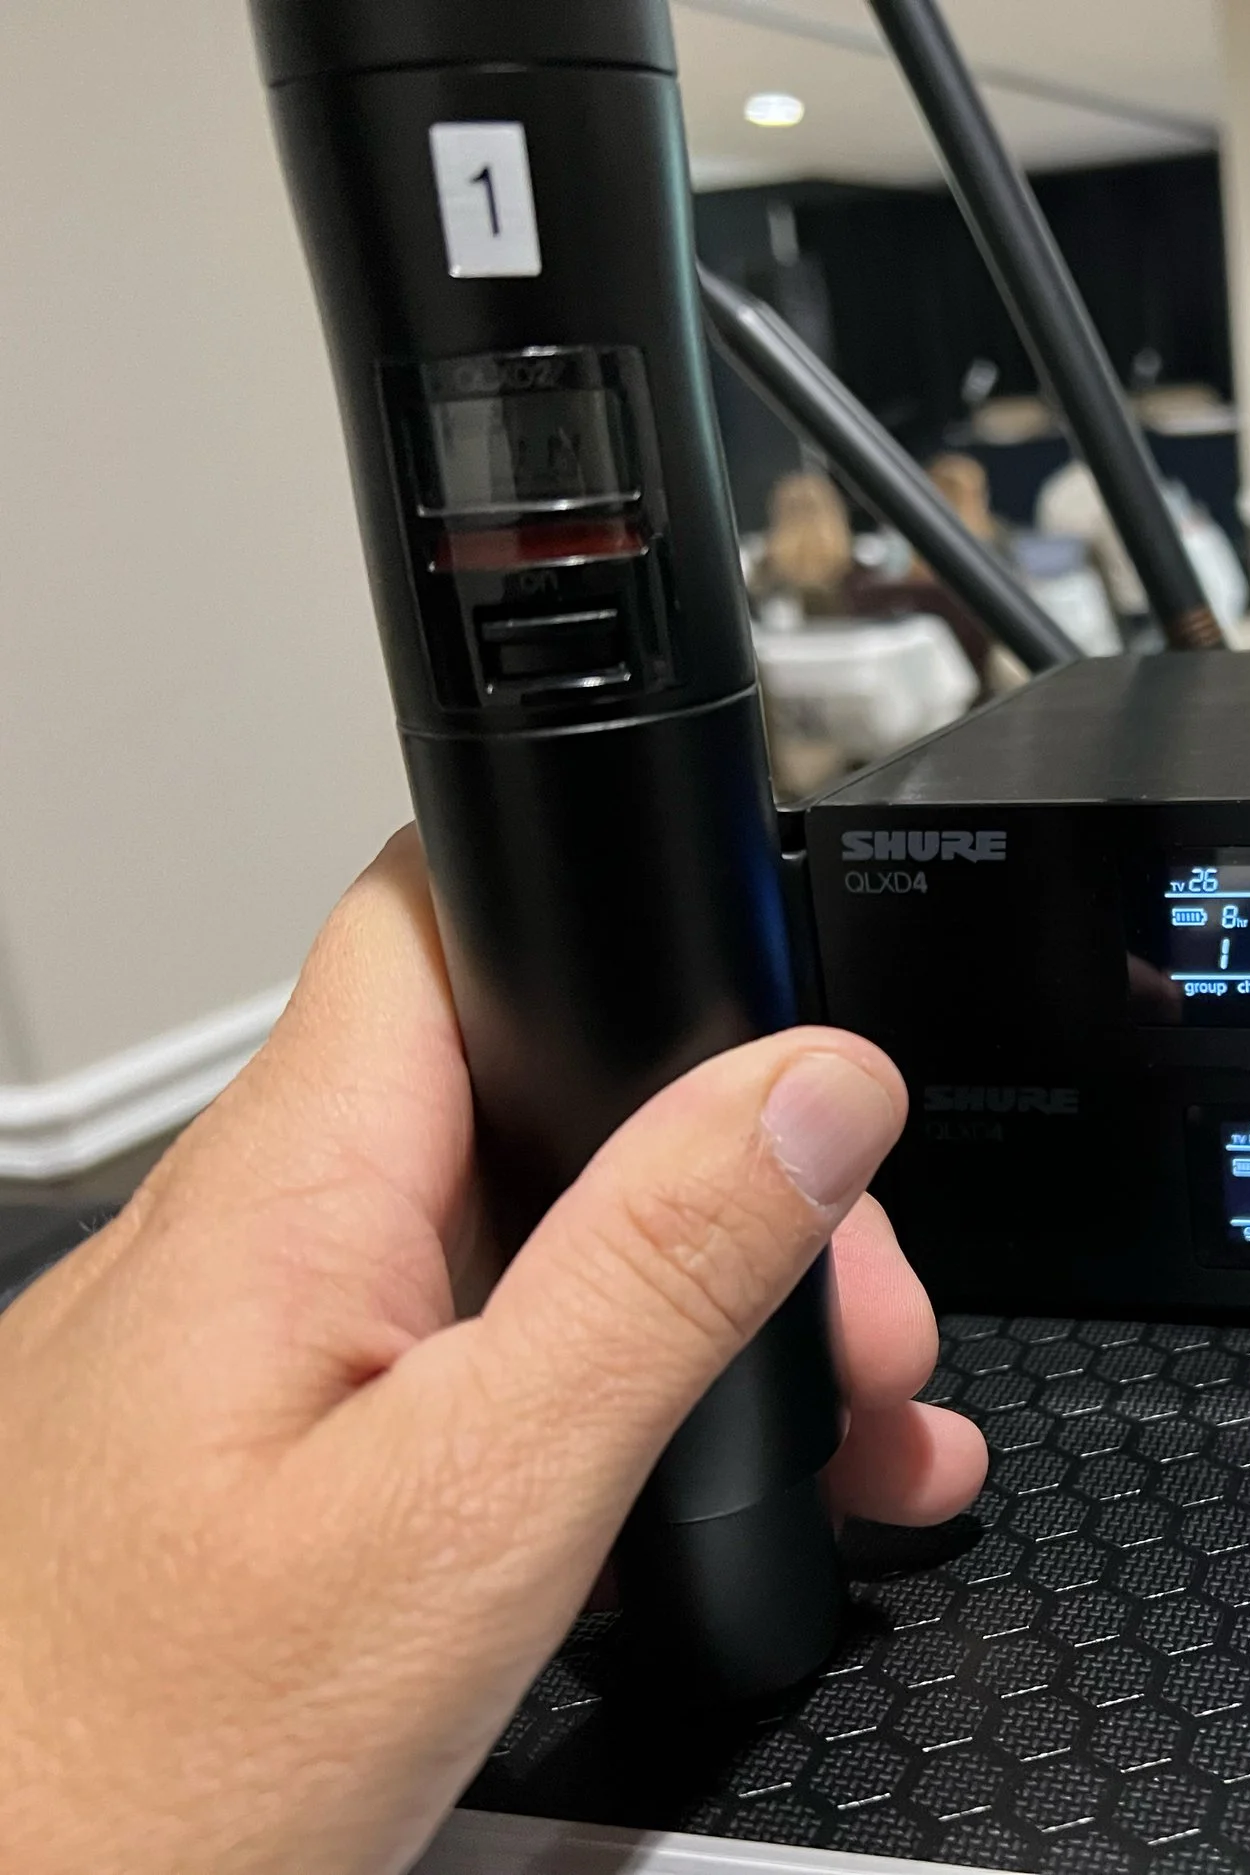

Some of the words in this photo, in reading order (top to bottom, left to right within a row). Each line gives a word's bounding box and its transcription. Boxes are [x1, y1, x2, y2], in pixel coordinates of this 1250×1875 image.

[469, 166, 500, 238] 1
[841, 830, 1008, 864] SHURE
[844, 871, 928, 895] QLXD4
[1188, 867, 1218, 893] 26
[1184, 982, 1228, 997] group
